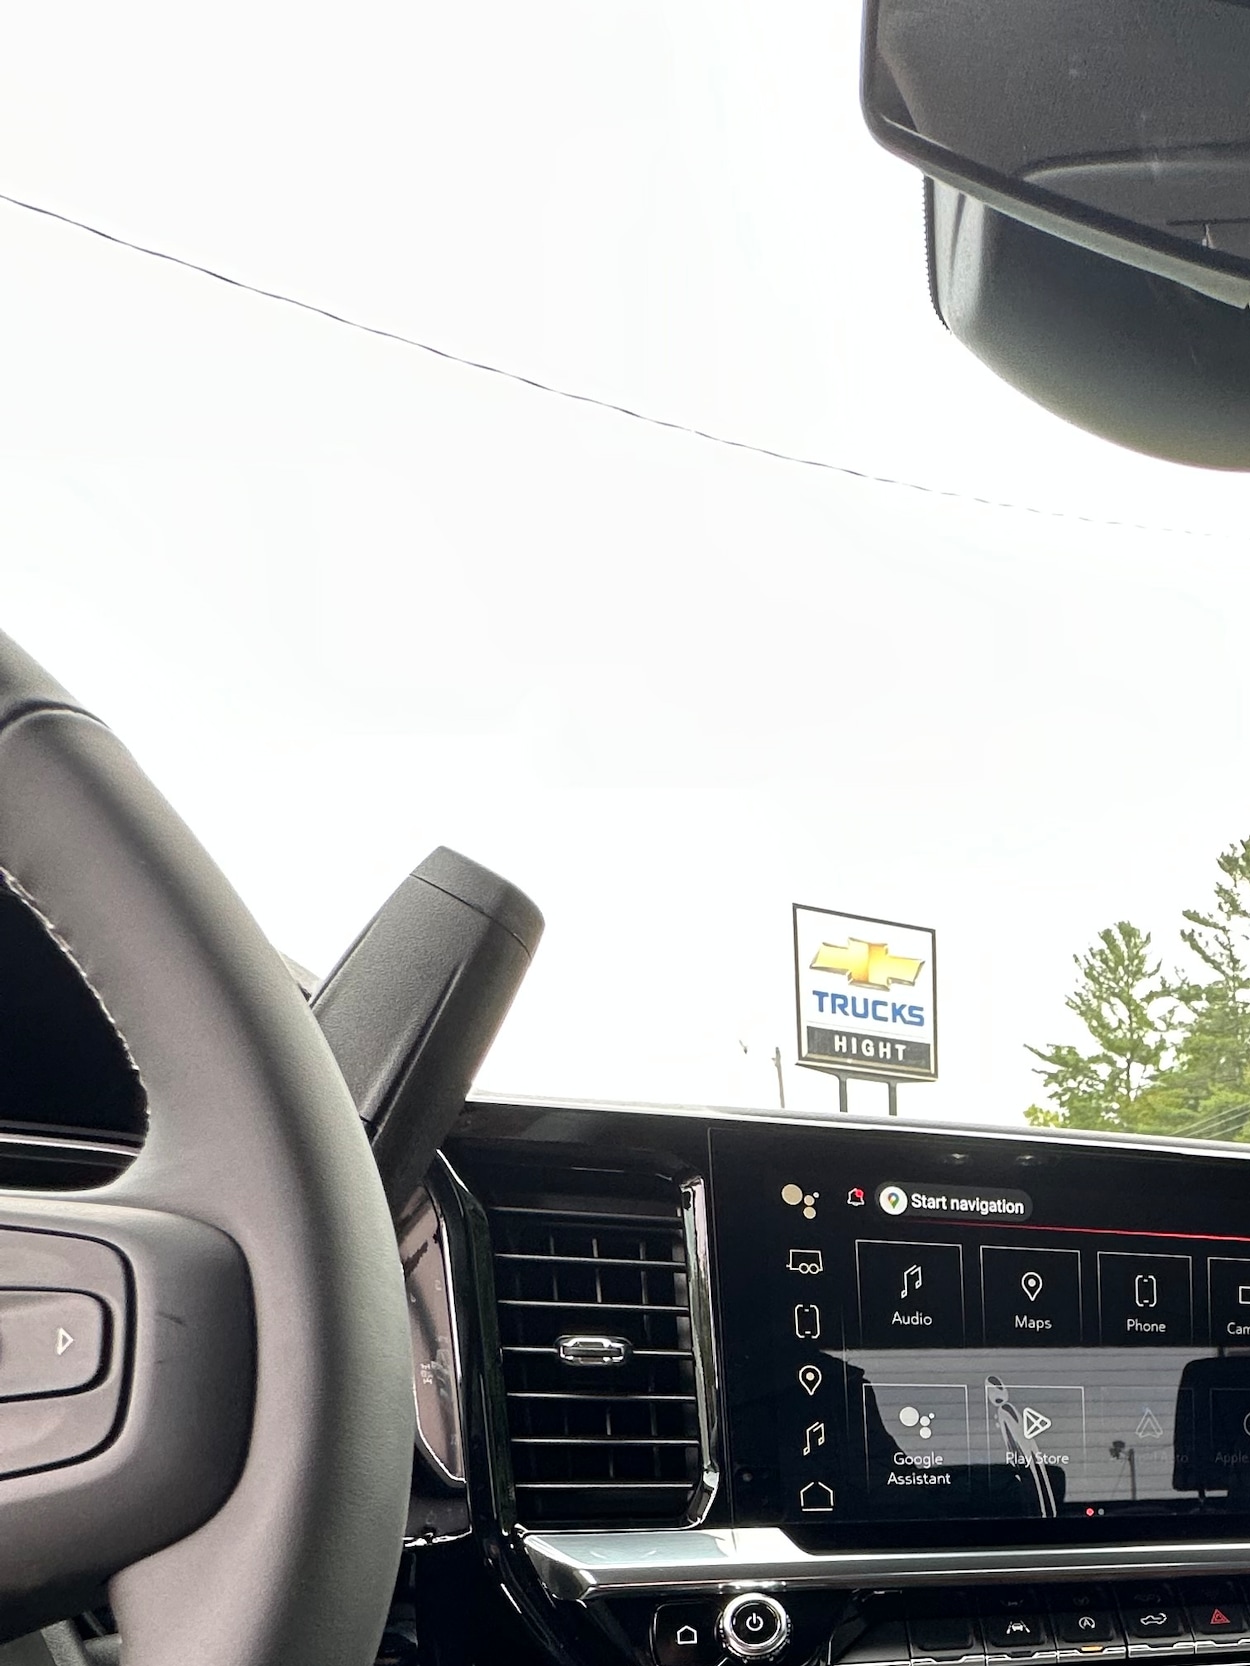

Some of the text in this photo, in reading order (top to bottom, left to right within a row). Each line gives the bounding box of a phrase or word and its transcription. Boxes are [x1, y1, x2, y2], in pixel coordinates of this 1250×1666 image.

[812, 990, 925, 1027] TRUCKS
[834, 1035, 907, 1061] HIGHT
[911, 1193, 1025, 1215] Start navigation
[892, 1311, 933, 1327] Audio
[1015, 1315, 1052, 1331] Maps
[1127, 1318, 1166, 1333] Phone
[893, 1452, 943, 1469] Google
[1005, 1451, 1069, 1468] Play Store
[1215, 1451, 1249, 1466] Apple
[887, 1472, 951, 1486] Assistant
